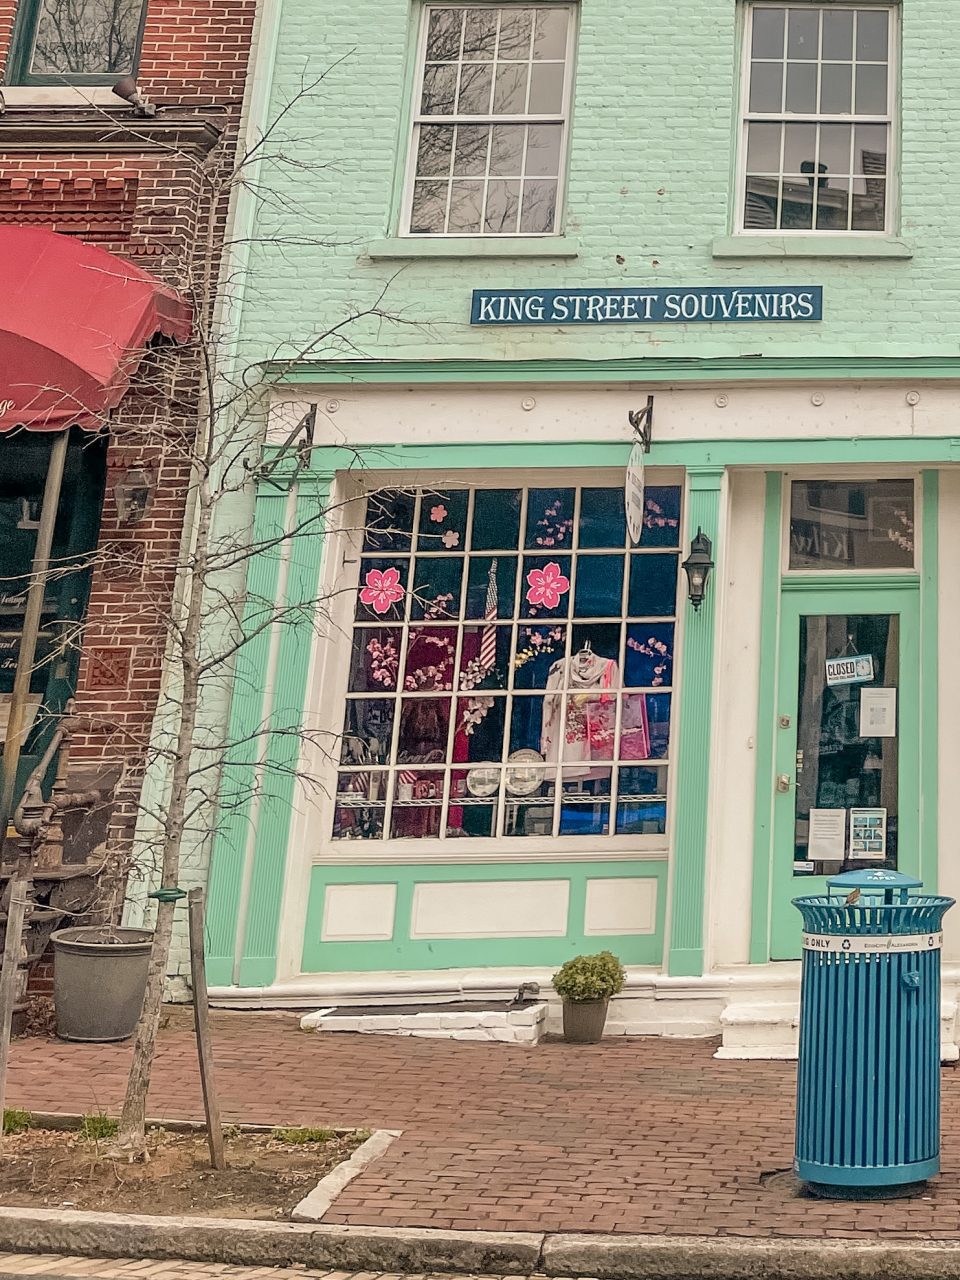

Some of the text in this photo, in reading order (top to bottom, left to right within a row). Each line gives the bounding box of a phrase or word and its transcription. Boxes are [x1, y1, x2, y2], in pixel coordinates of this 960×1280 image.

[479, 289, 814, 321] KING STREET SOUVENIRS
[827, 661, 855, 677] CLOSED
[811, 937, 831, 948] ONLY
